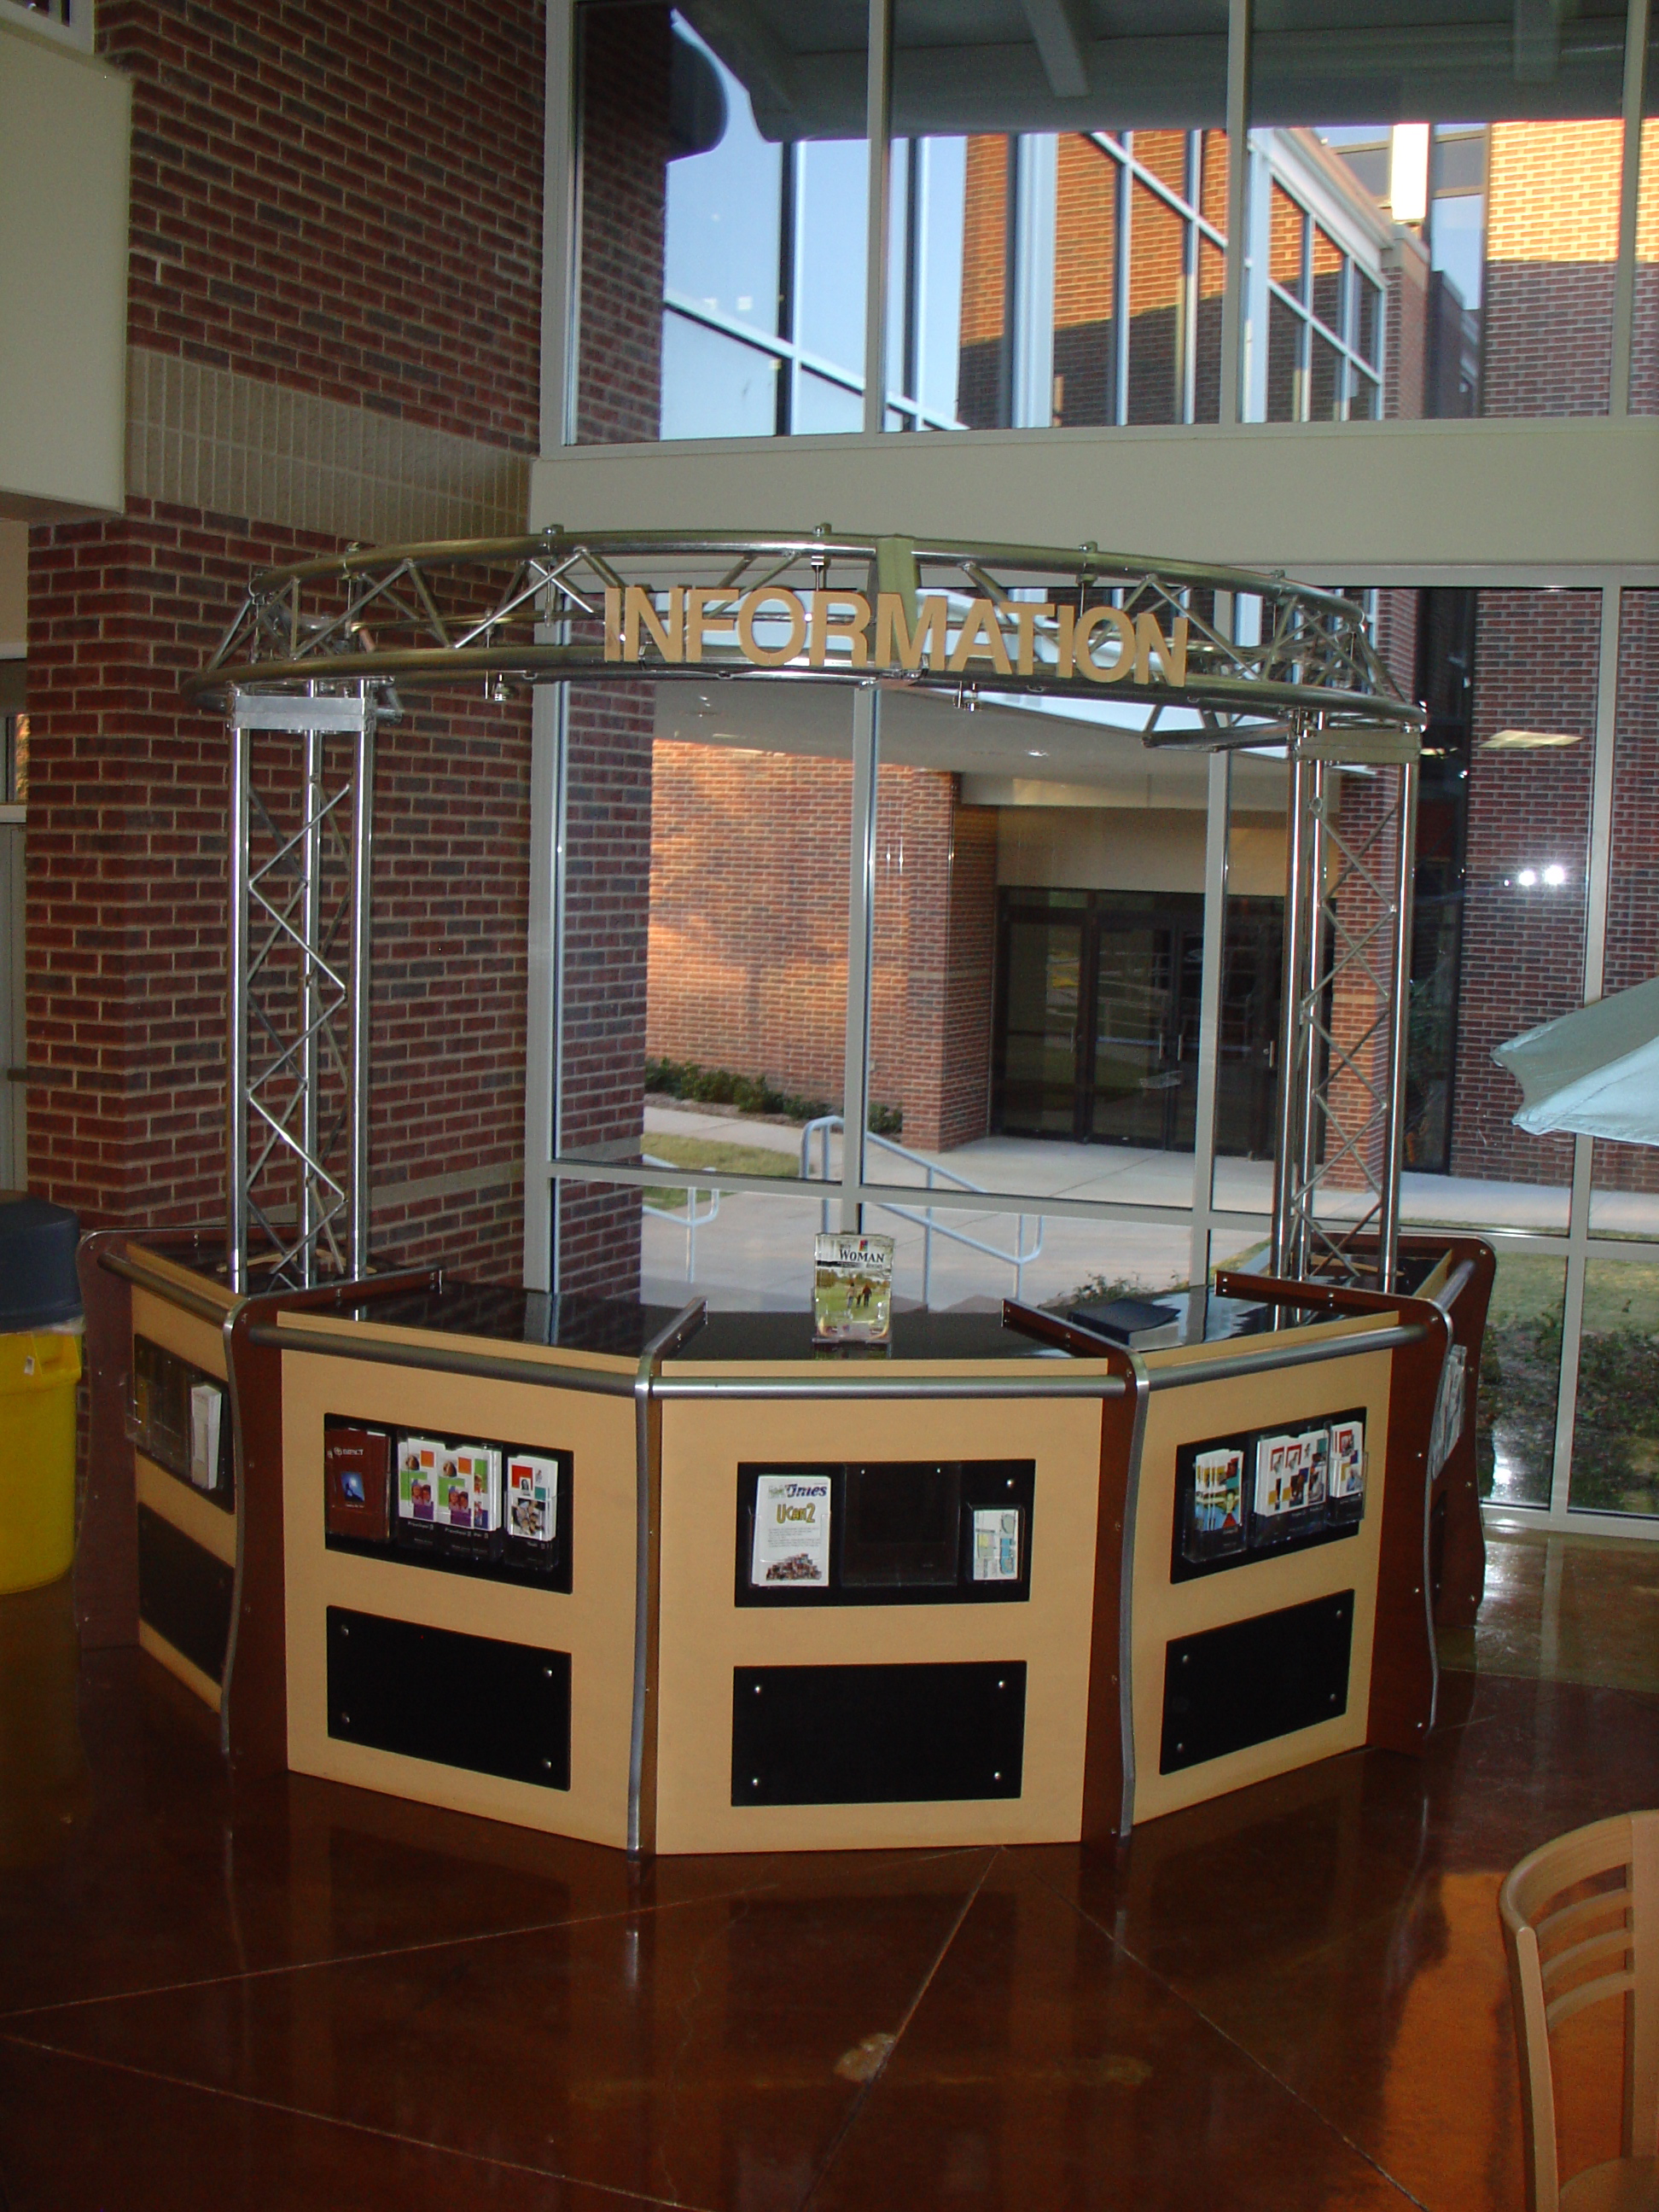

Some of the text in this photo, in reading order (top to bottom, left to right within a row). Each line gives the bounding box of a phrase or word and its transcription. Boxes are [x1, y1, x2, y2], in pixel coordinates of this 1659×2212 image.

[603, 585, 1187, 687] INFORMATION
[839, 1249, 885, 1263] WOMAN
[785, 1483, 828, 1499] Times
